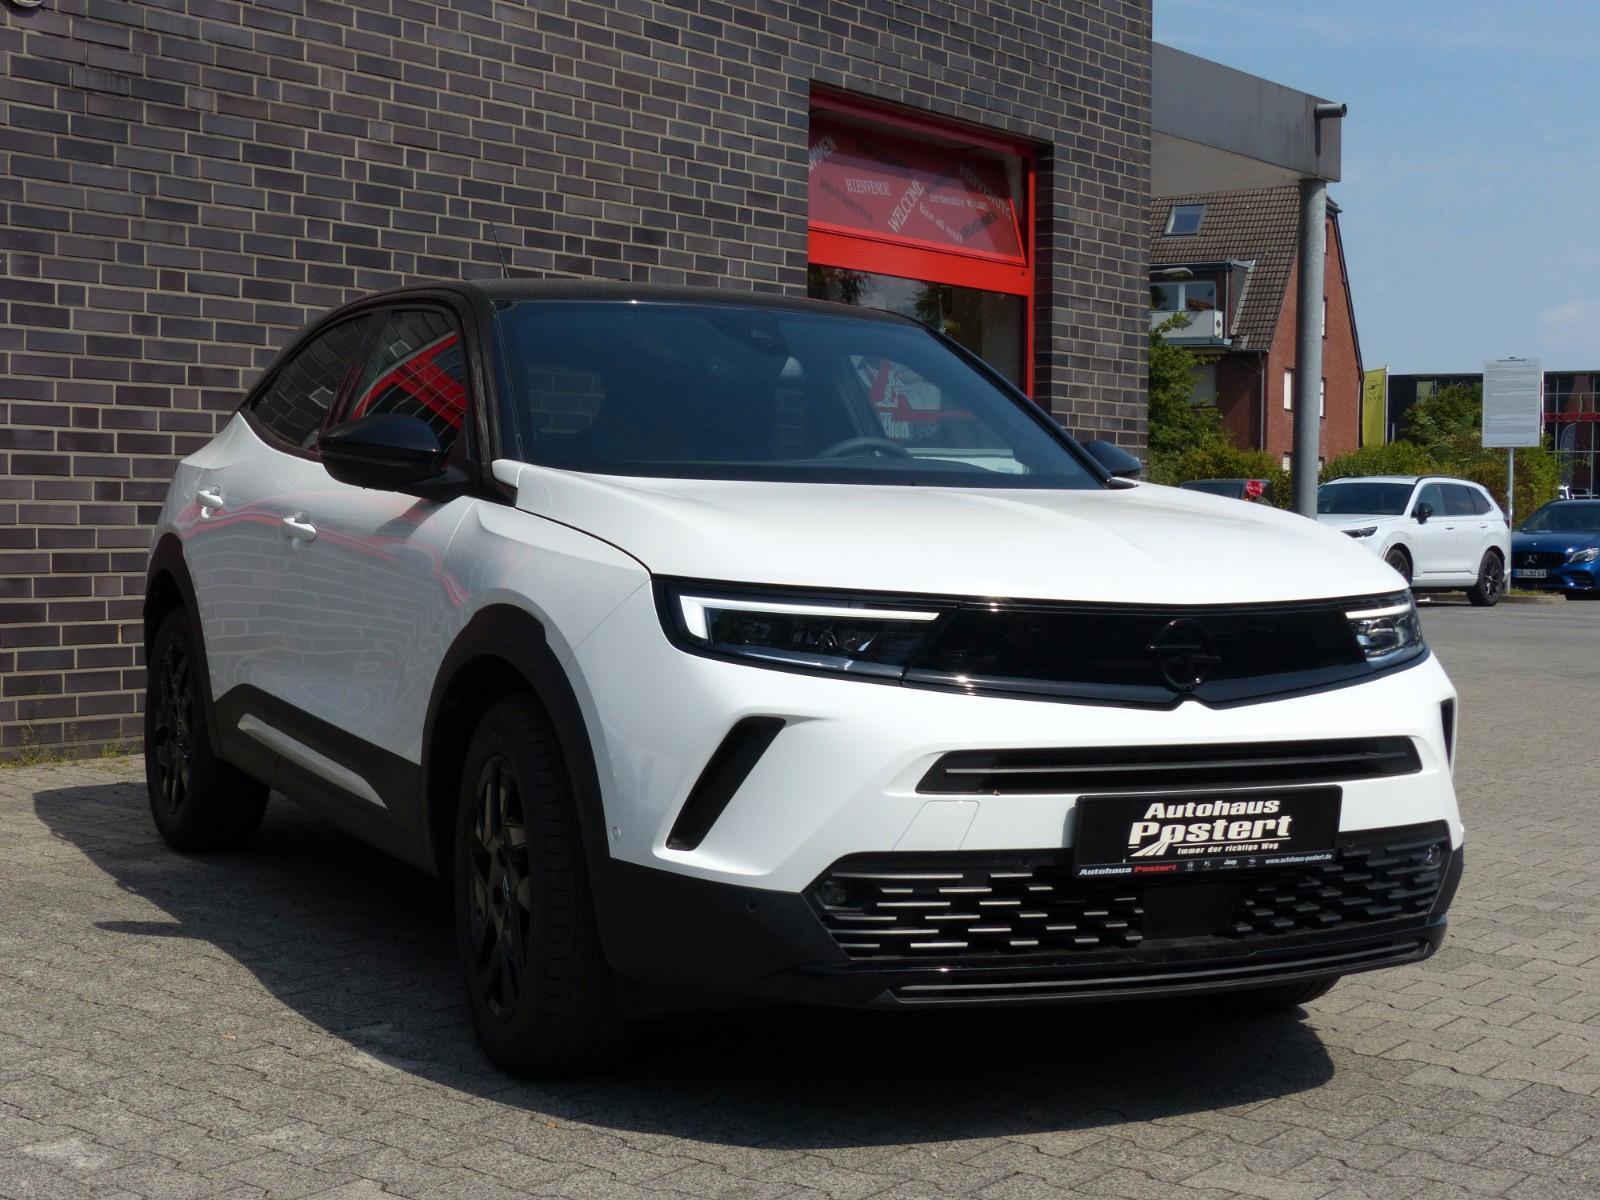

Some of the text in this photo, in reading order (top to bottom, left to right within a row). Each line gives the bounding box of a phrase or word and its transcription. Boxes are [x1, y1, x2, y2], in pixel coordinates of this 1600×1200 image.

[887, 176, 925, 233] WELCOME
[1143, 800, 1281, 820] Autohaus
[1128, 815, 1292, 846] Postert
[1177, 842, 1279, 856] Immer der richtige Weg
[1265, 854, 1333, 865] www.autohaus-postert.de
[1079, 864, 1177, 876] Autohaus Postert
